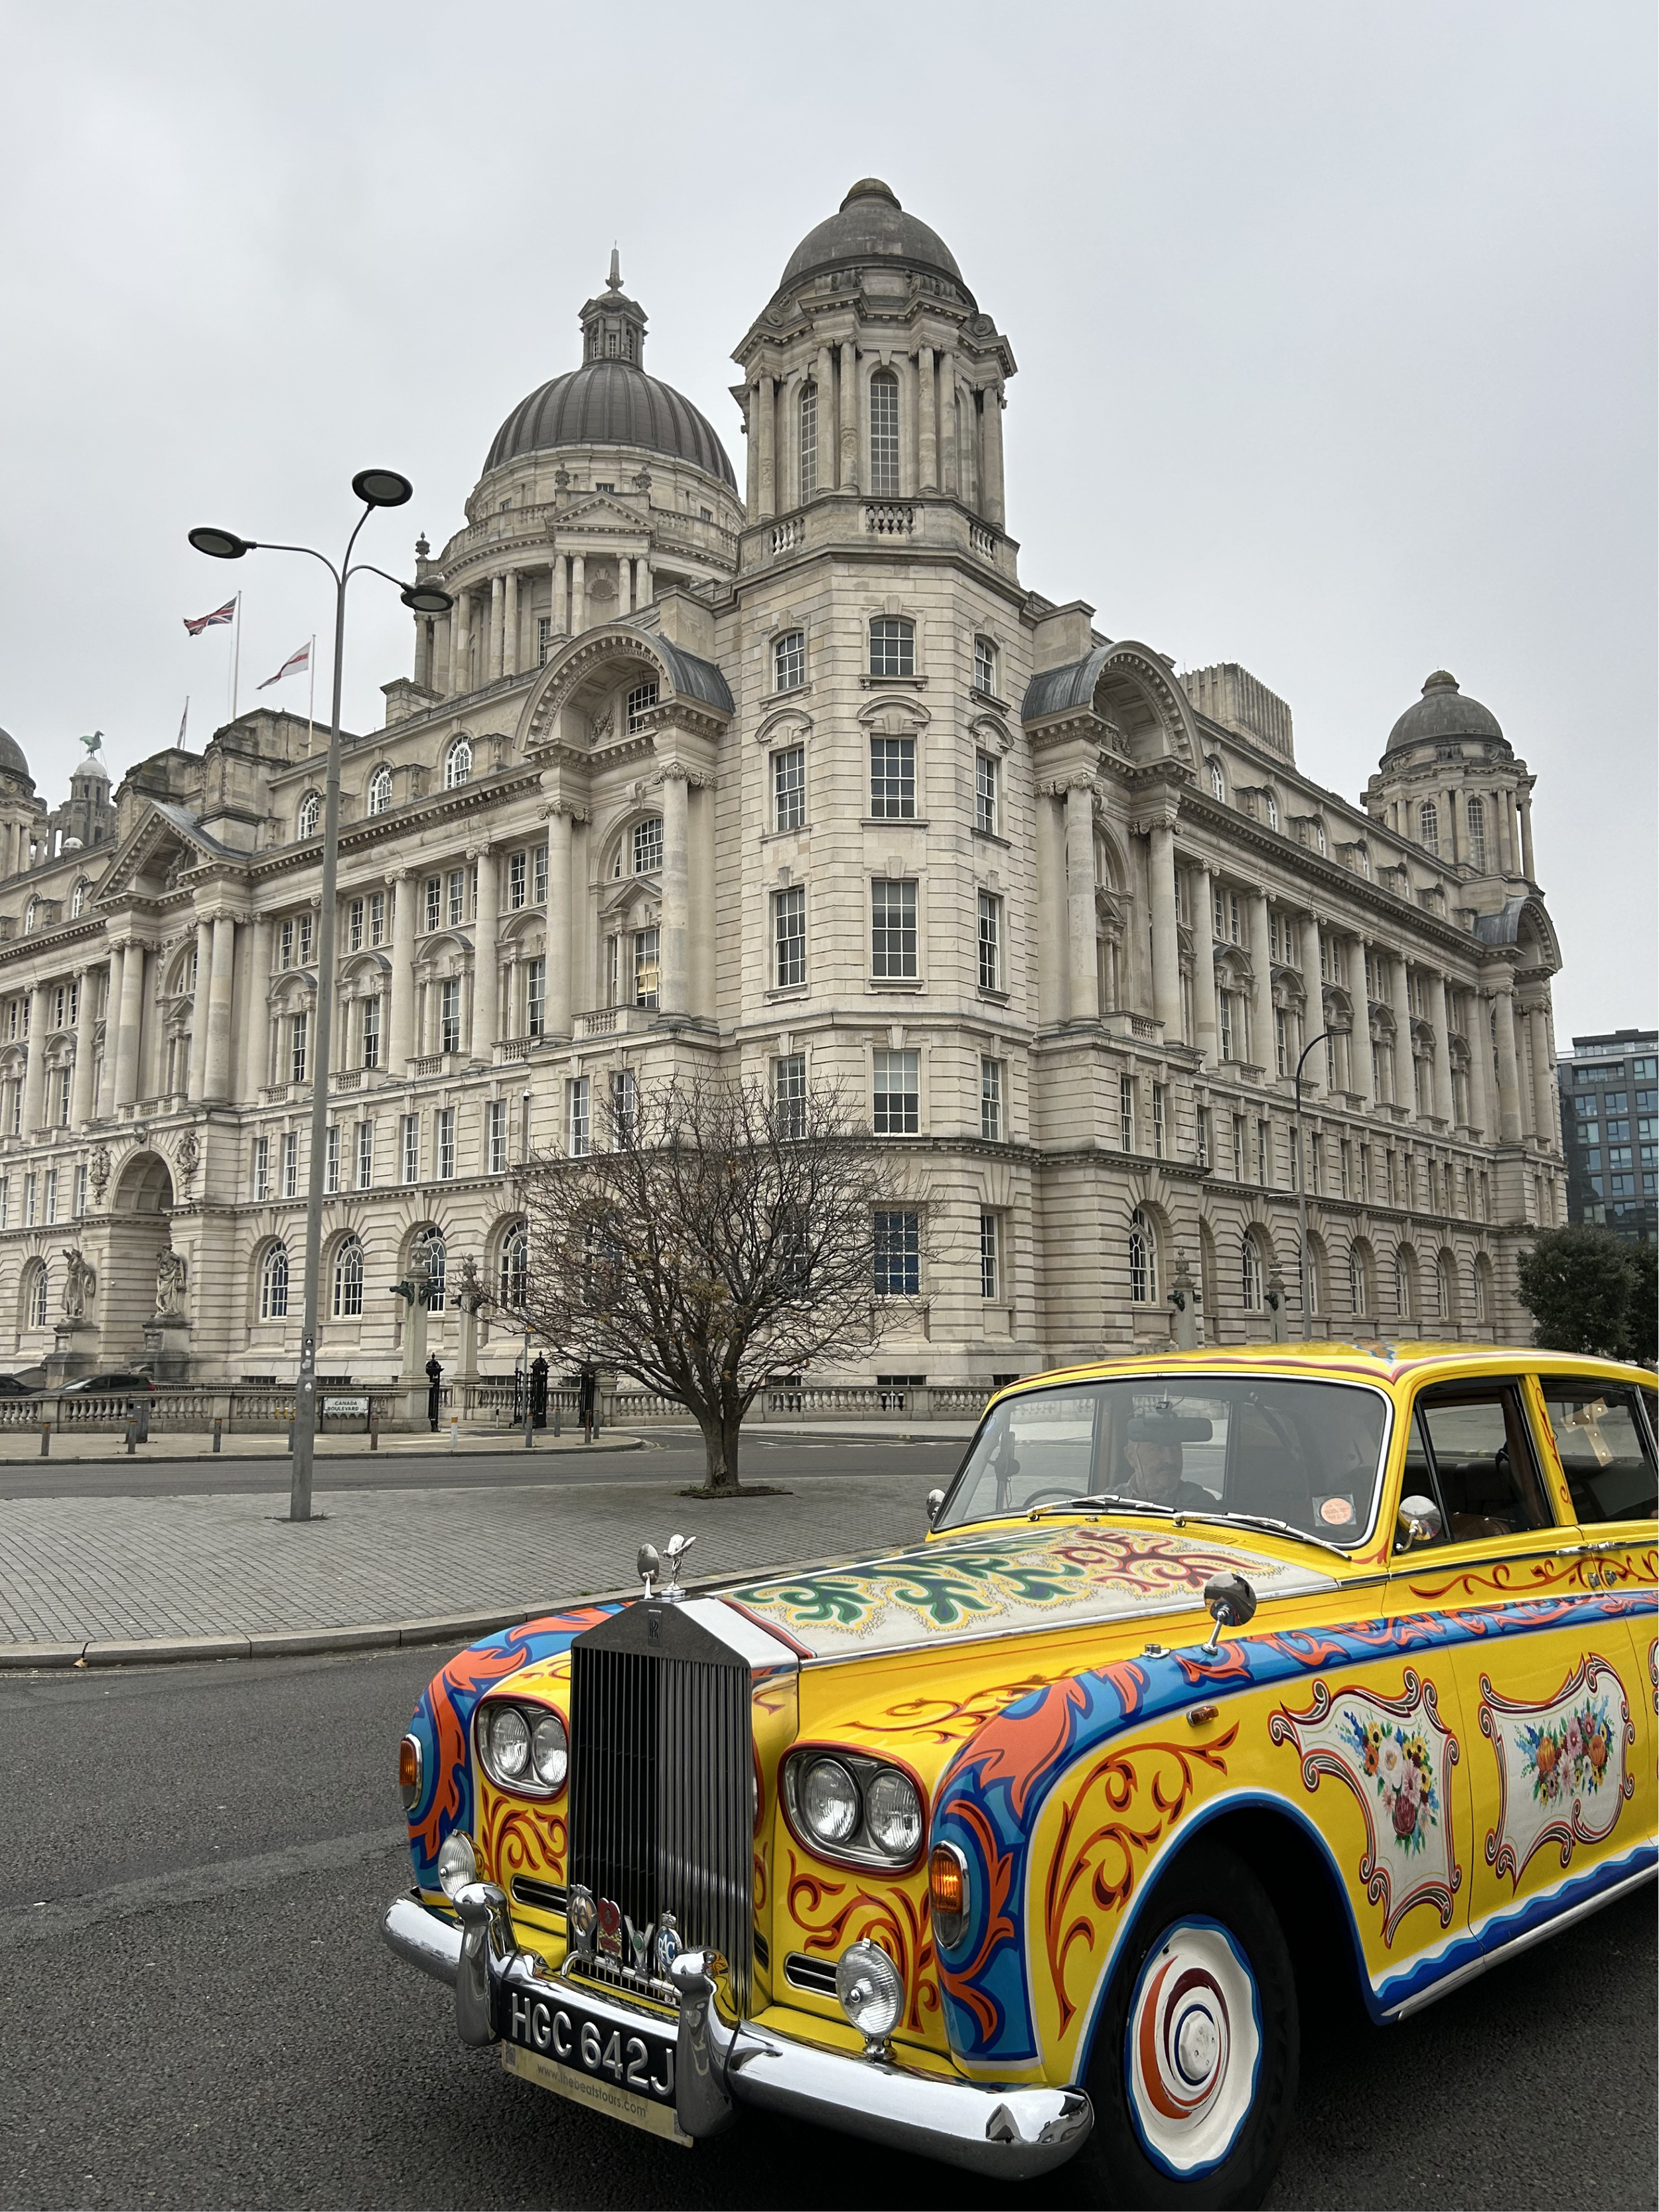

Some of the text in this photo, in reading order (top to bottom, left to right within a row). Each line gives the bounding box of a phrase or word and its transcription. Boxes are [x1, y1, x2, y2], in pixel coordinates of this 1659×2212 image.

[658, 1933, 676, 1965] RAC
[512, 1992, 674, 2097] HGC 642J
[537, 2061, 646, 2118] www.thebeatstours.com
